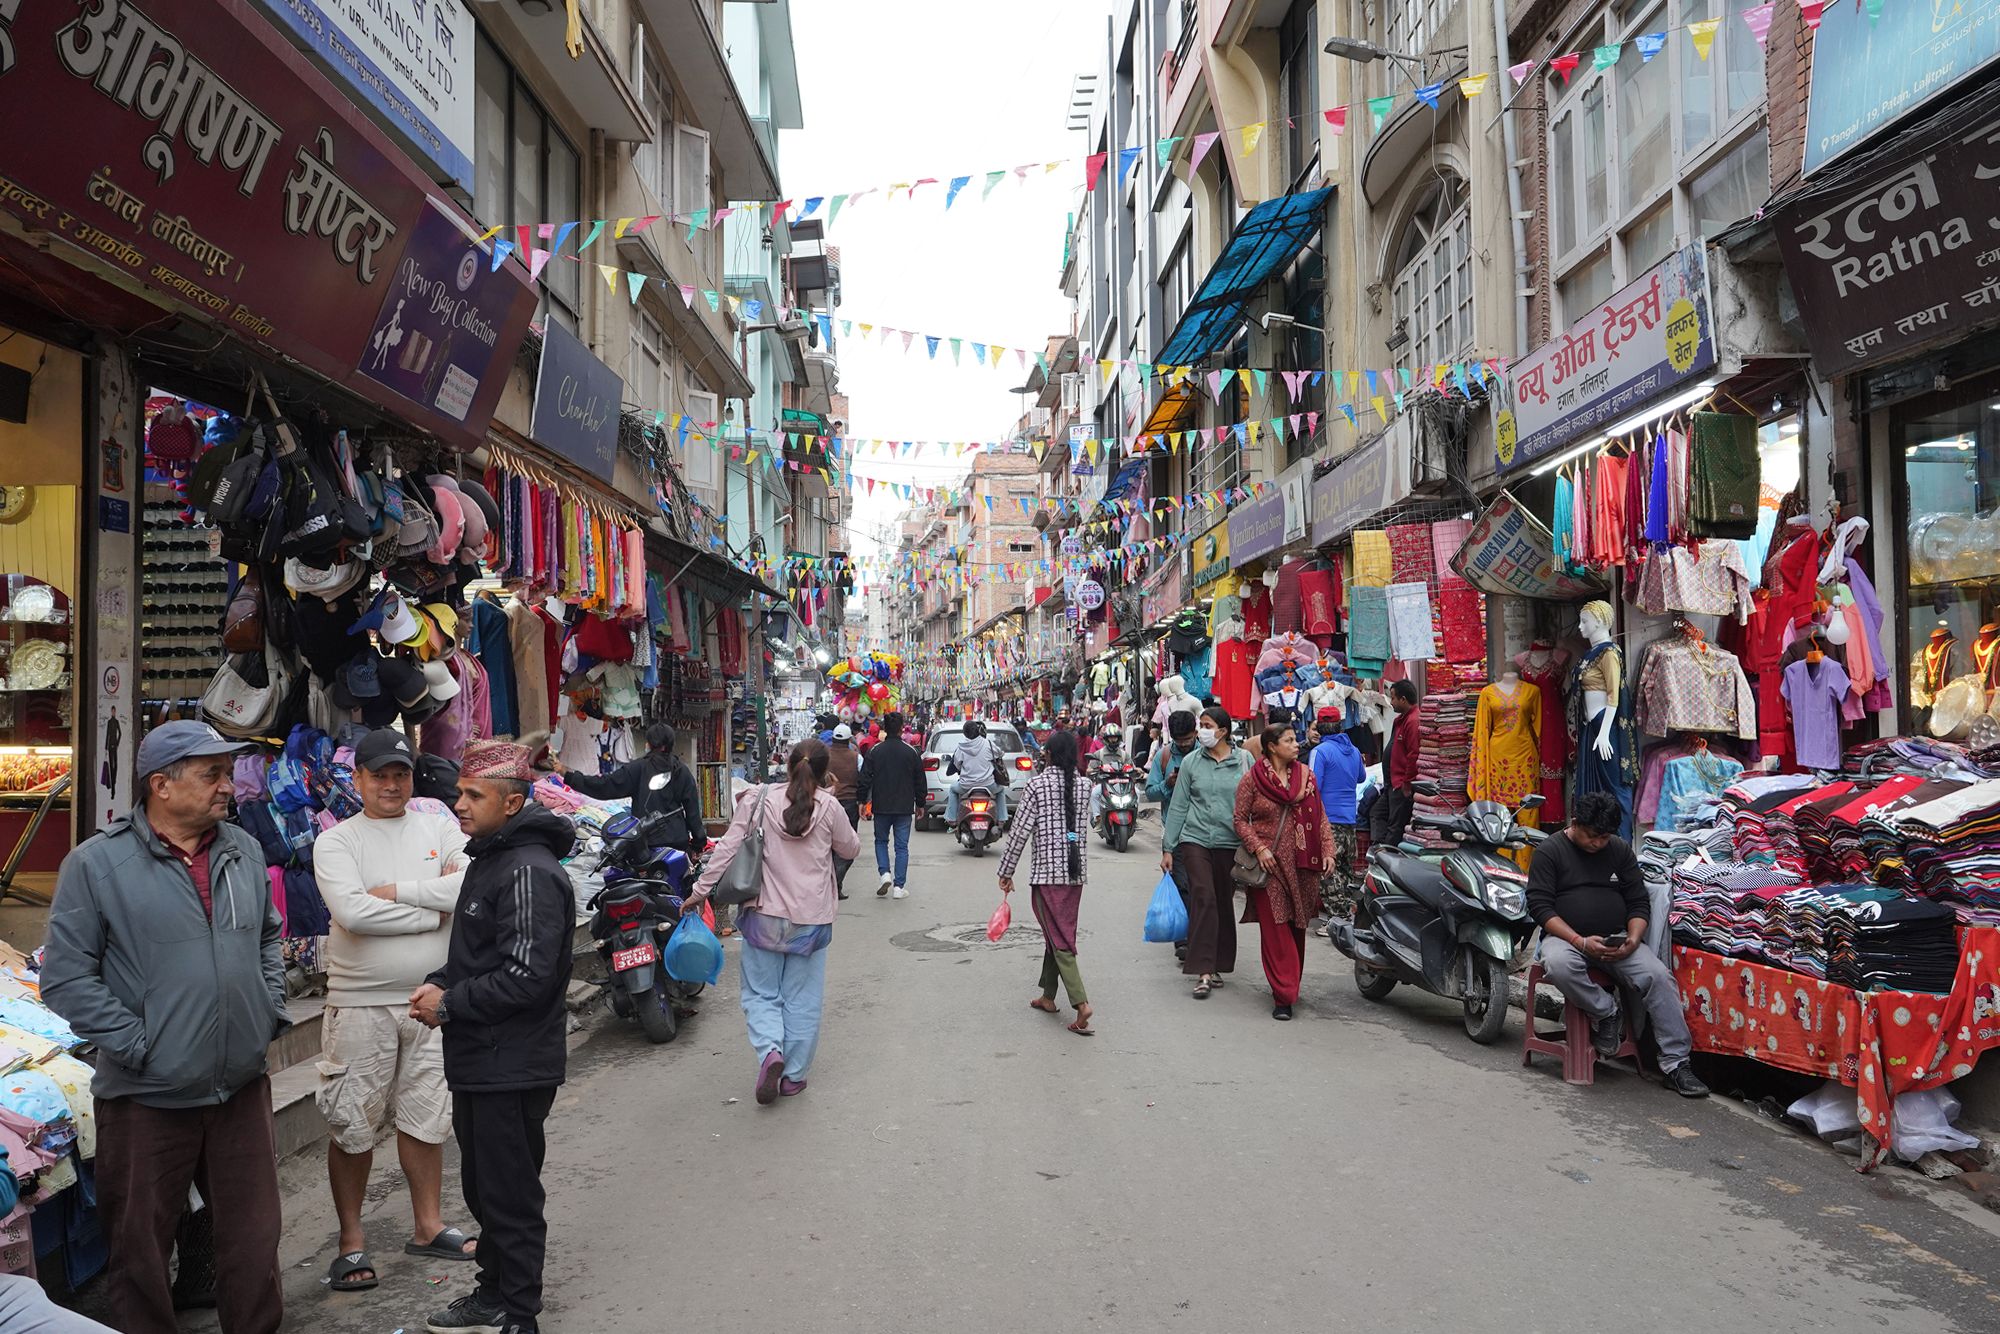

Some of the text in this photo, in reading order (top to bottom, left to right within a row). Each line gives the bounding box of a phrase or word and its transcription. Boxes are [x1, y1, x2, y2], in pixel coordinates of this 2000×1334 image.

[349, 5, 369, 37] URL:
[427, 48, 457, 101] LTD.
[1830, 121, 1860, 146] Tangal
[150, 208, 235, 277] ललितपुर
[1831, 216, 1973, 298] Ratna
[401, 256, 499, 348] New Bag Collection
[1673, 340, 1693, 364] सेल
[1843, 327, 1884, 358] सुन
[1894, 302, 1950, 336] तथा
[1517, 362, 1550, 406] न्यू
[1550, 327, 1597, 387] ओम
[212, 477, 232, 506] JORDAN
[1473, 541, 1501, 571] LADIES
[1493, 530, 1512, 550] ALL
